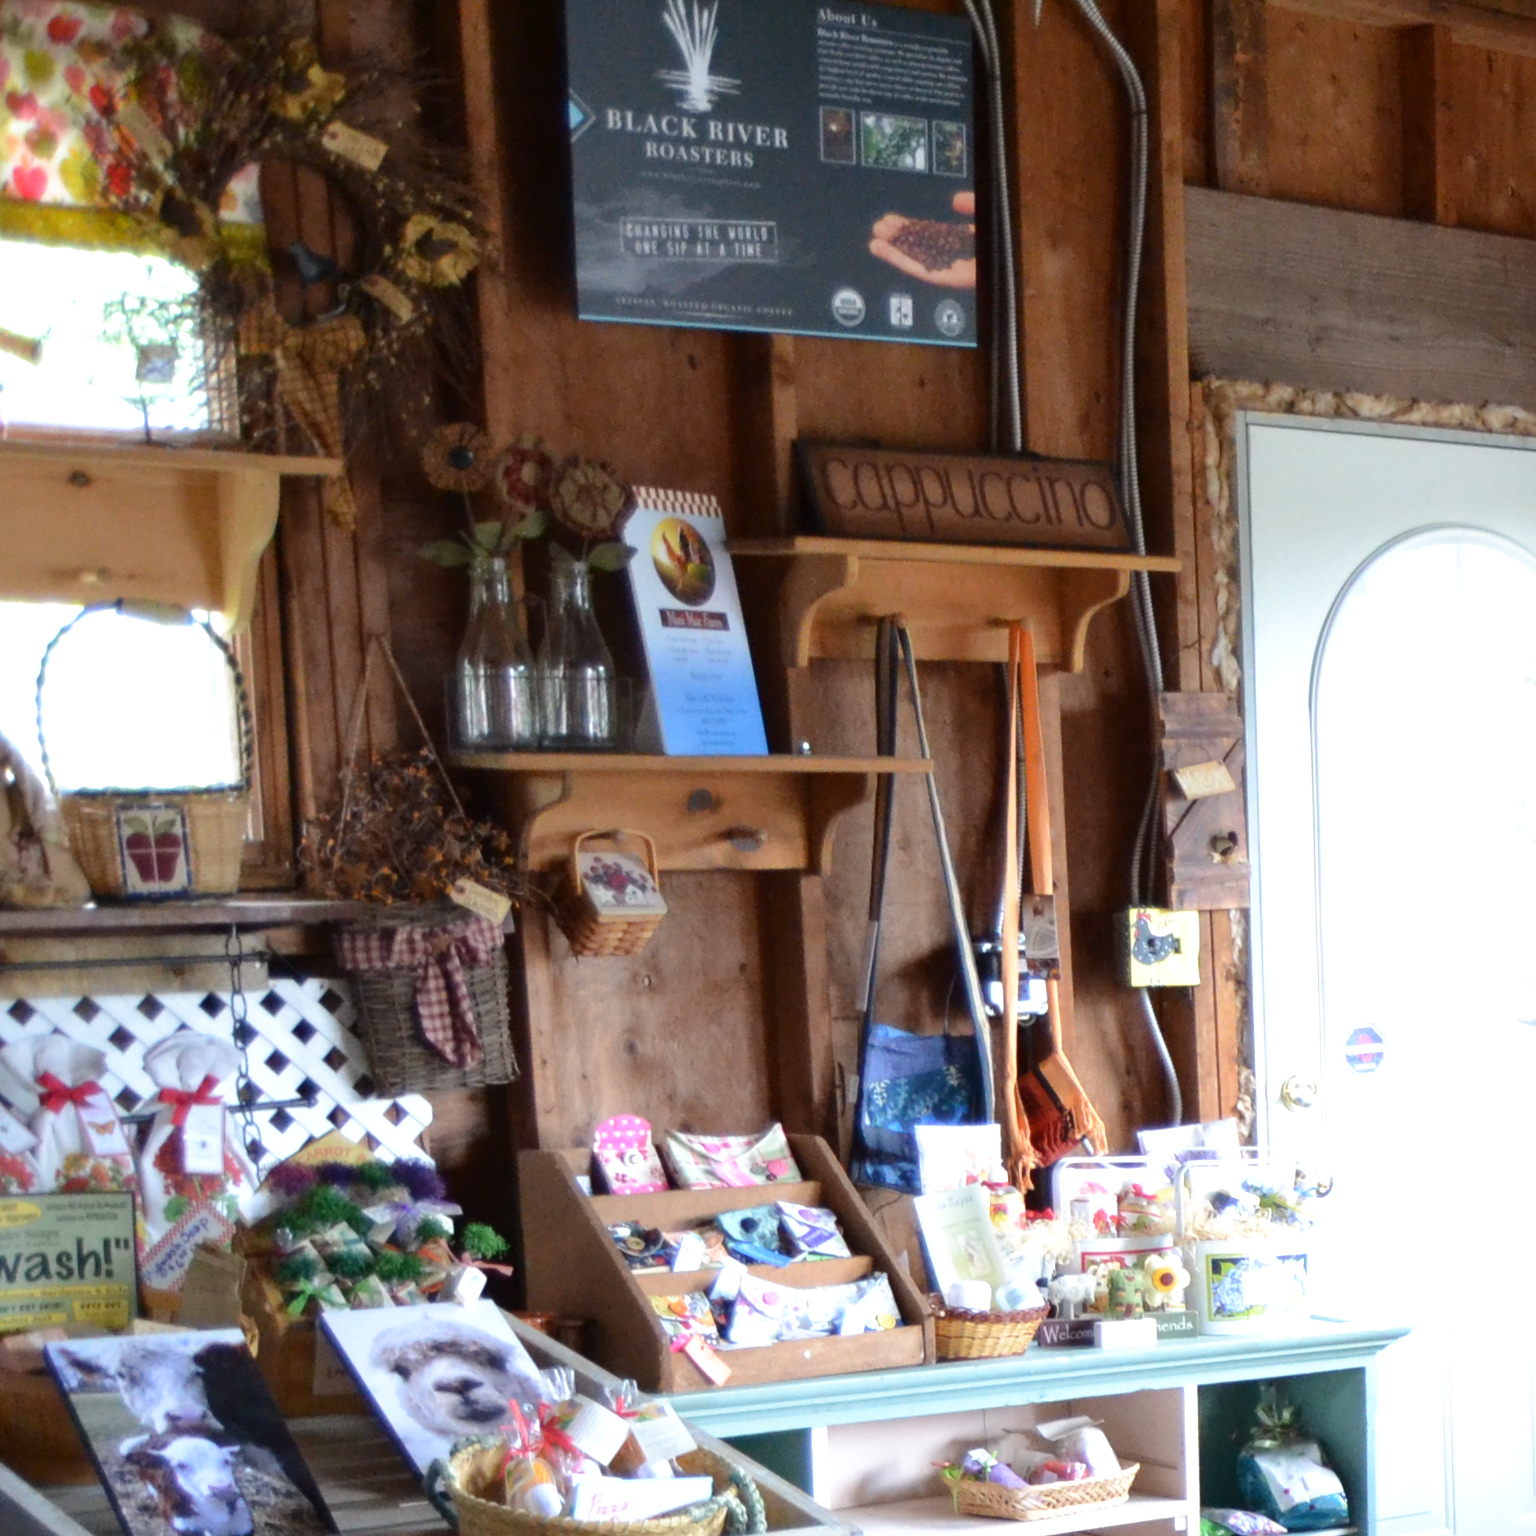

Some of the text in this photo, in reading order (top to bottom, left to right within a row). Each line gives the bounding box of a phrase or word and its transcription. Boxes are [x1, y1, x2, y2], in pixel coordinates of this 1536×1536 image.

[817, 8, 878, 27] About Us
[606, 108, 789, 149] BLACK RIVER
[645, 141, 755, 168] ROASTERS
[626, 223, 768, 242] CHANGING THE WORLD
[634, 240, 762, 258] ONE SIP AT A TIME
[821, 459, 1116, 534] cappuccino
[1043, 1323, 1094, 1344] Welcom
